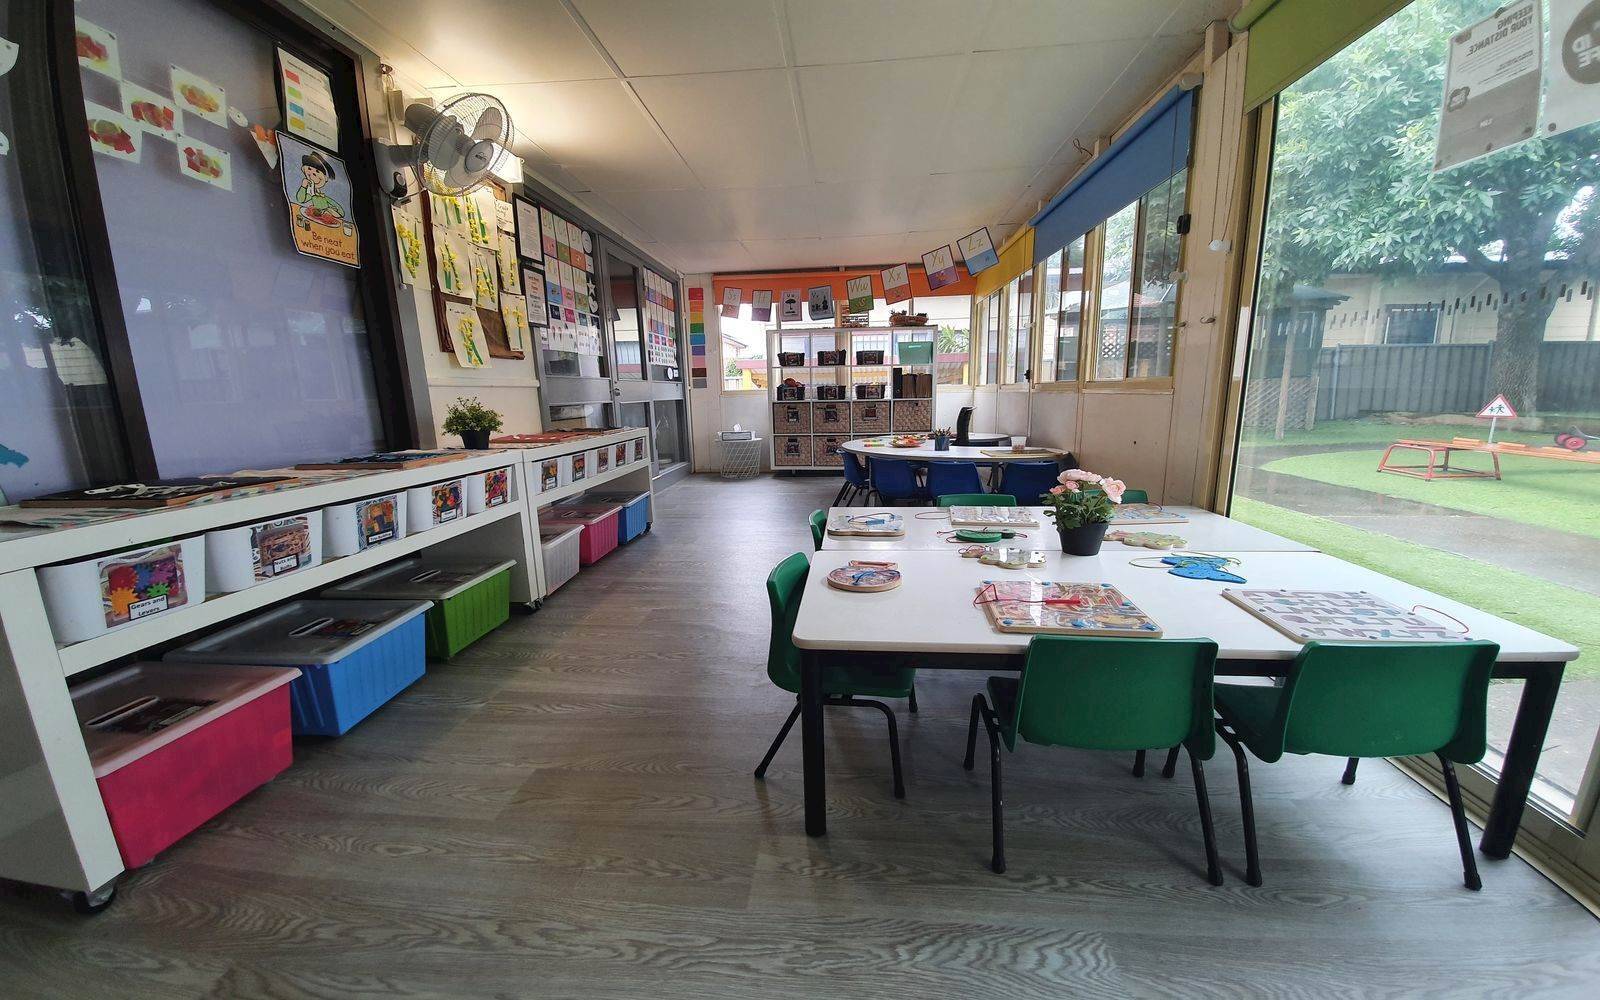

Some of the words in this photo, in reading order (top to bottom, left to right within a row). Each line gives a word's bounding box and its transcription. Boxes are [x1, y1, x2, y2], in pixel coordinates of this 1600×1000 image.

[312, 231, 322, 242] Be
[323, 237, 343, 248] neat
[301, 240, 324, 251] when
[325, 246, 341, 256] you
[341, 251, 355, 260] eat
[153, 596, 165, 604] and
[138, 607, 160, 616] Levers
